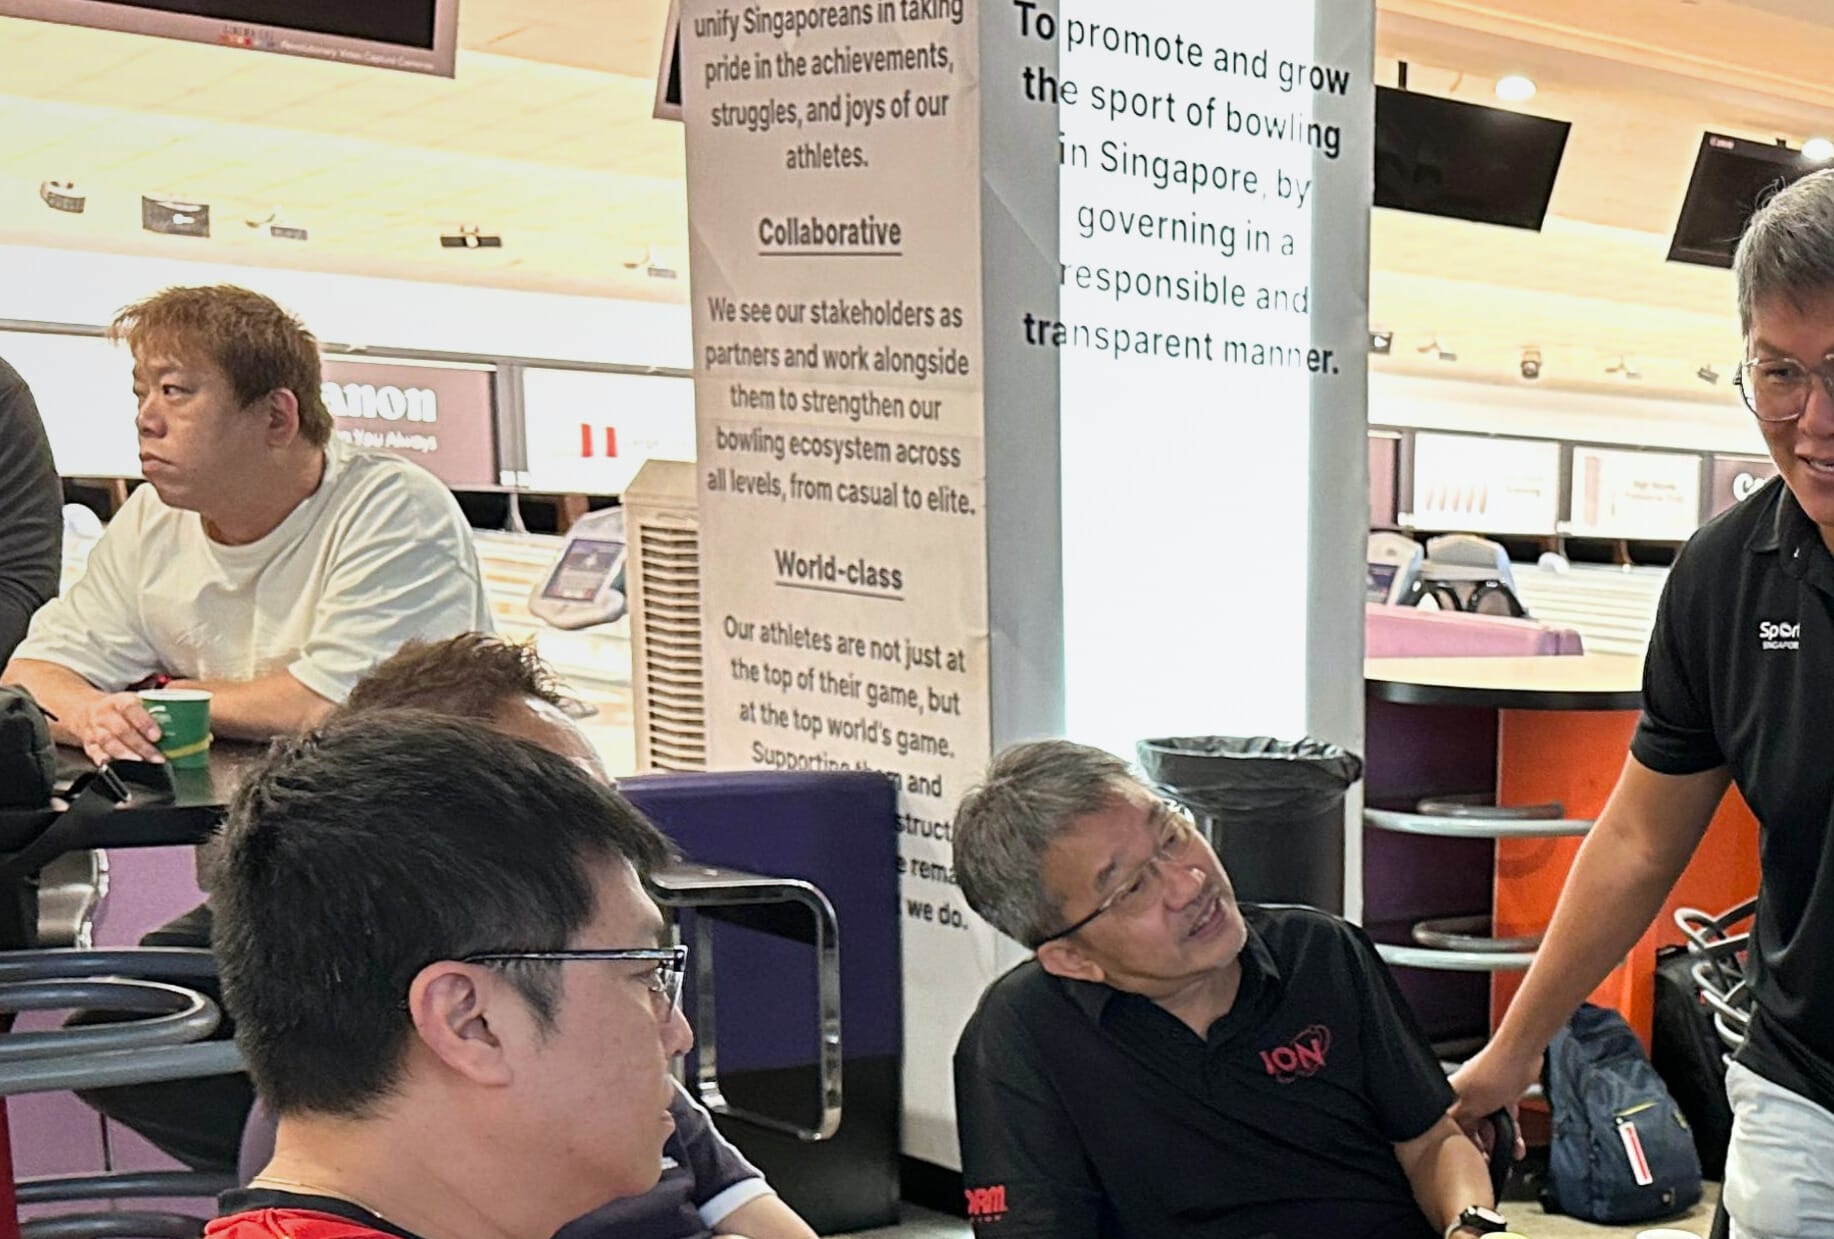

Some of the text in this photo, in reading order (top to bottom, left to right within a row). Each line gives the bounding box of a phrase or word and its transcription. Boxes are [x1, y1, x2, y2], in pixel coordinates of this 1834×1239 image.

[695, 0, 964, 42] unify Singaporeans in taking
[704, 43, 954, 89] pride in the achievements,
[1013, 0, 1350, 95] To promote and grow
[711, 90, 949, 131] struggles, and joys of our
[1023, 66, 1341, 160] the sport of bowling
[786, 143, 869, 169] athletes.
[1058, 132, 1312, 208] in Singapore, by
[759, 215, 902, 246] Collaborative
[1077, 205, 1294, 258] governing in a
[1060, 262, 1310, 314] responsible and
[708, 297, 963, 328] We see our stakeholders as
[705, 343, 970, 379] partners and work alongside
[1023, 312, 1339, 375] transparent manner.
[321, 380, 437, 423] anon
[730, 384, 942, 422] them to strengthen our
[716, 427, 961, 468] bowling ecosystem across
[707, 468, 977, 515] all levels, from casual to elite.
[775, 549, 903, 590] World-class
[724, 615, 966, 673] Our athletes are not just at
[731, 658, 961, 716] the top of their game, but
[740, 702, 956, 758] at the top world's game.
[908, 774, 942, 798] and
[907, 899, 968, 929] we do.
[1259, 1039, 1326, 1075] ION
